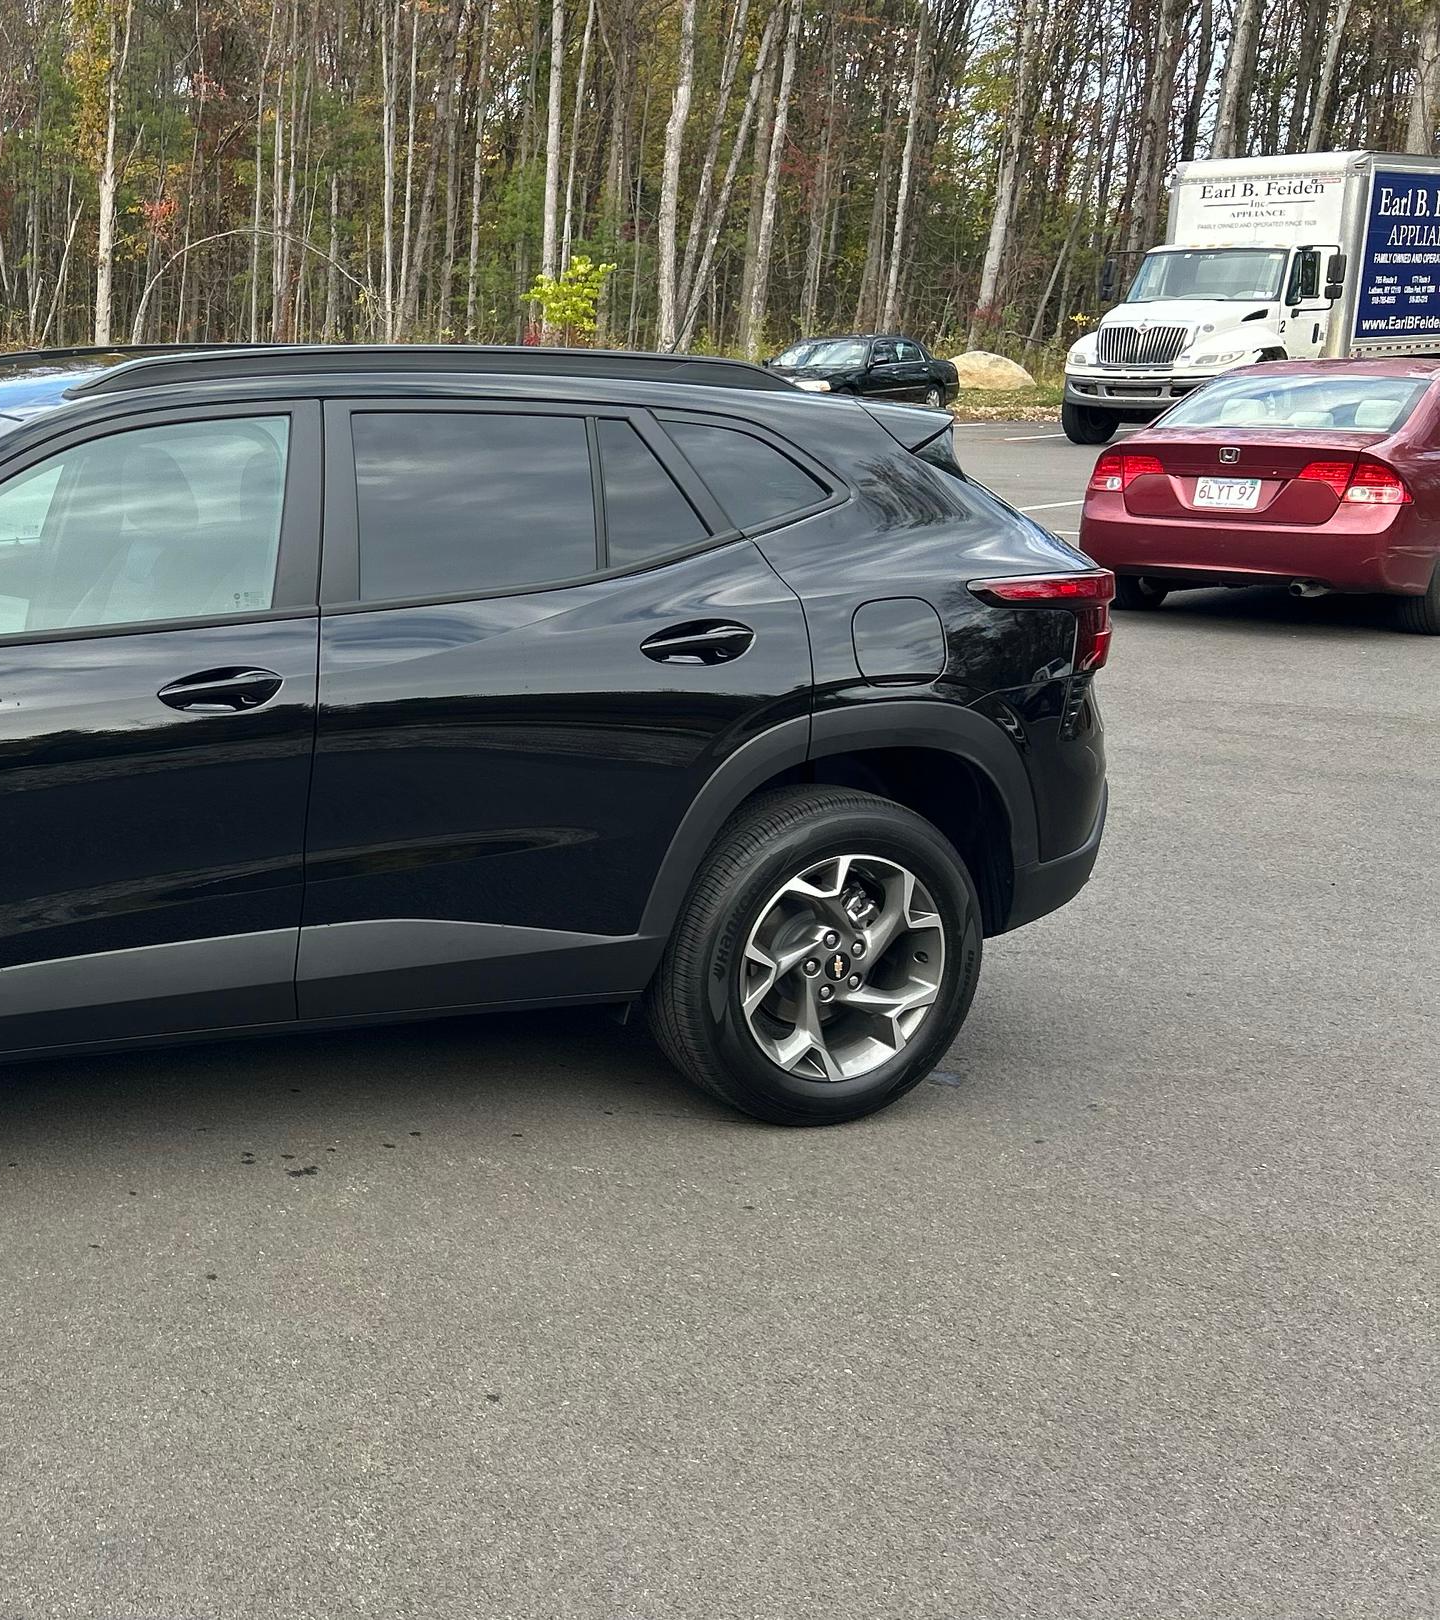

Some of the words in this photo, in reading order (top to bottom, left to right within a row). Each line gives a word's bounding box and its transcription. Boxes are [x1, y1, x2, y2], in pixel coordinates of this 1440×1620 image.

[1200, 184, 1235, 200] Earl
[1242, 182, 1259, 198] B.
[1265, 180, 1325, 197] Feiden
[1378, 187, 1413, 217] Earl
[1414, 189, 1430, 217] B.
[1387, 224, 1440, 247] APPLIA
[1374, 252, 1393, 264] FAMILY
[1411, 252, 1423, 264] AND
[1280, 320, 1286, 333] 2
[1362, 314, 1440, 331] www.EarlBFeide
[1198, 484, 1234, 500] 6LYT
[1237, 485, 1256, 501] 97
